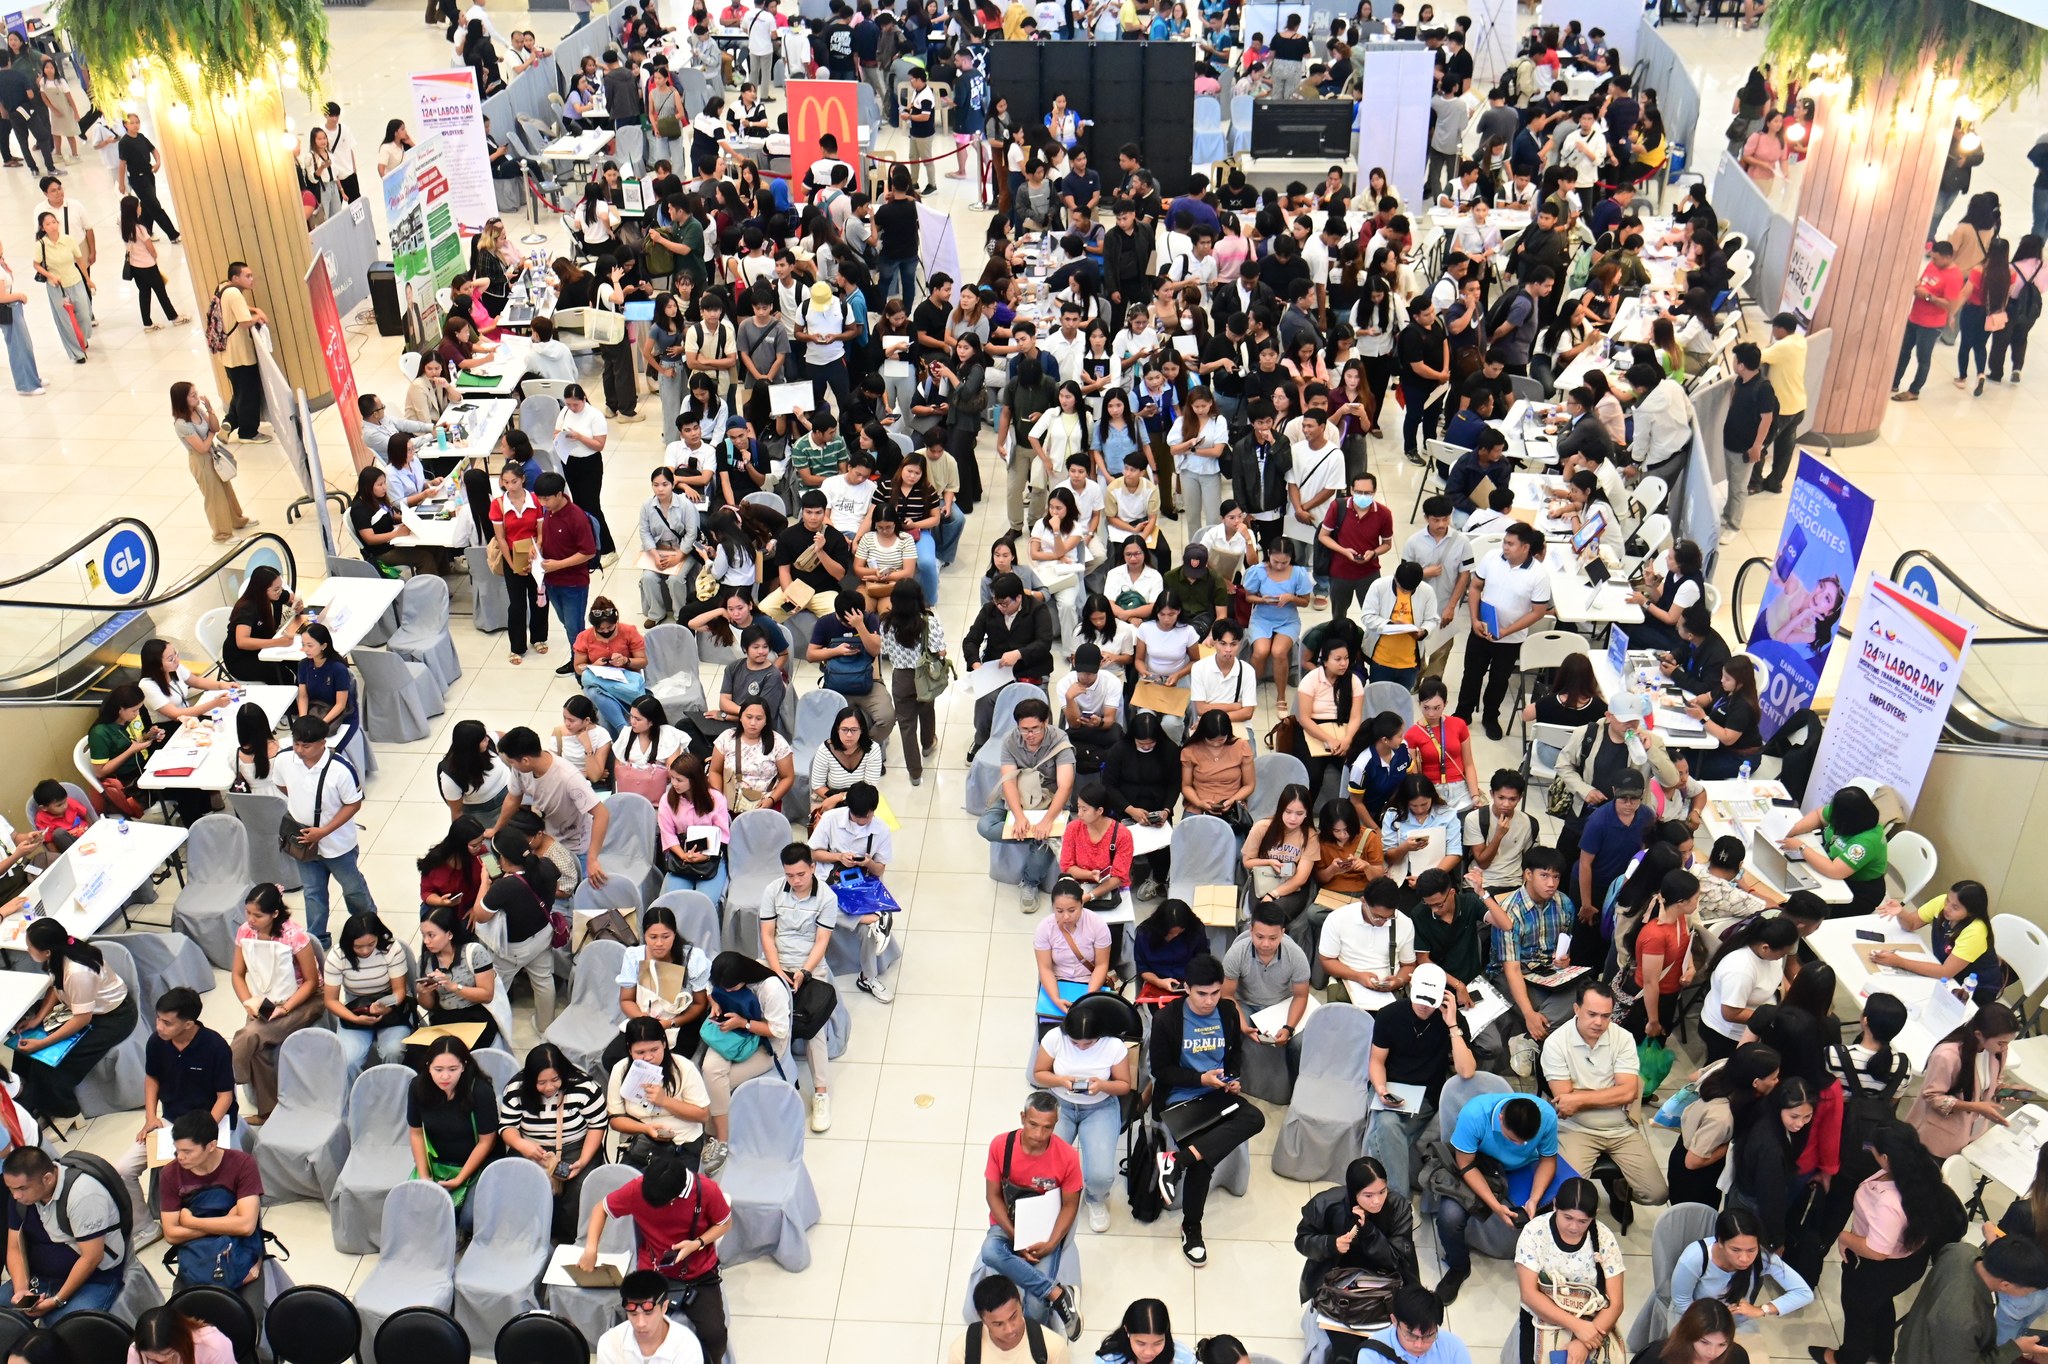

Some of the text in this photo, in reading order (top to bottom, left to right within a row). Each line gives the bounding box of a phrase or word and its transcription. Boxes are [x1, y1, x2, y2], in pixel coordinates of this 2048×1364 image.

[437, 105, 460, 116] LABOR
[461, 104, 474, 114] DAY
[1793, 488, 1821, 517] SALES
[1804, 482, 1814, 496] ONE
[1815, 491, 1823, 501] OF
[1823, 498, 1837, 511] OUR
[1789, 503, 1846, 553] ASSOCIATES
[111, 546, 141, 578] GL
[1780, 659, 1814, 691] EARN UP TO
[1862, 640, 1944, 697] 124TH LABOR DAY
[1901, 682, 1913, 694] PARA
[1868, 692, 1908, 722] EMPLOYERS:
[1183, 1038, 1225, 1049] DENIM
[1563, 1298, 1584, 1309] JERUS
